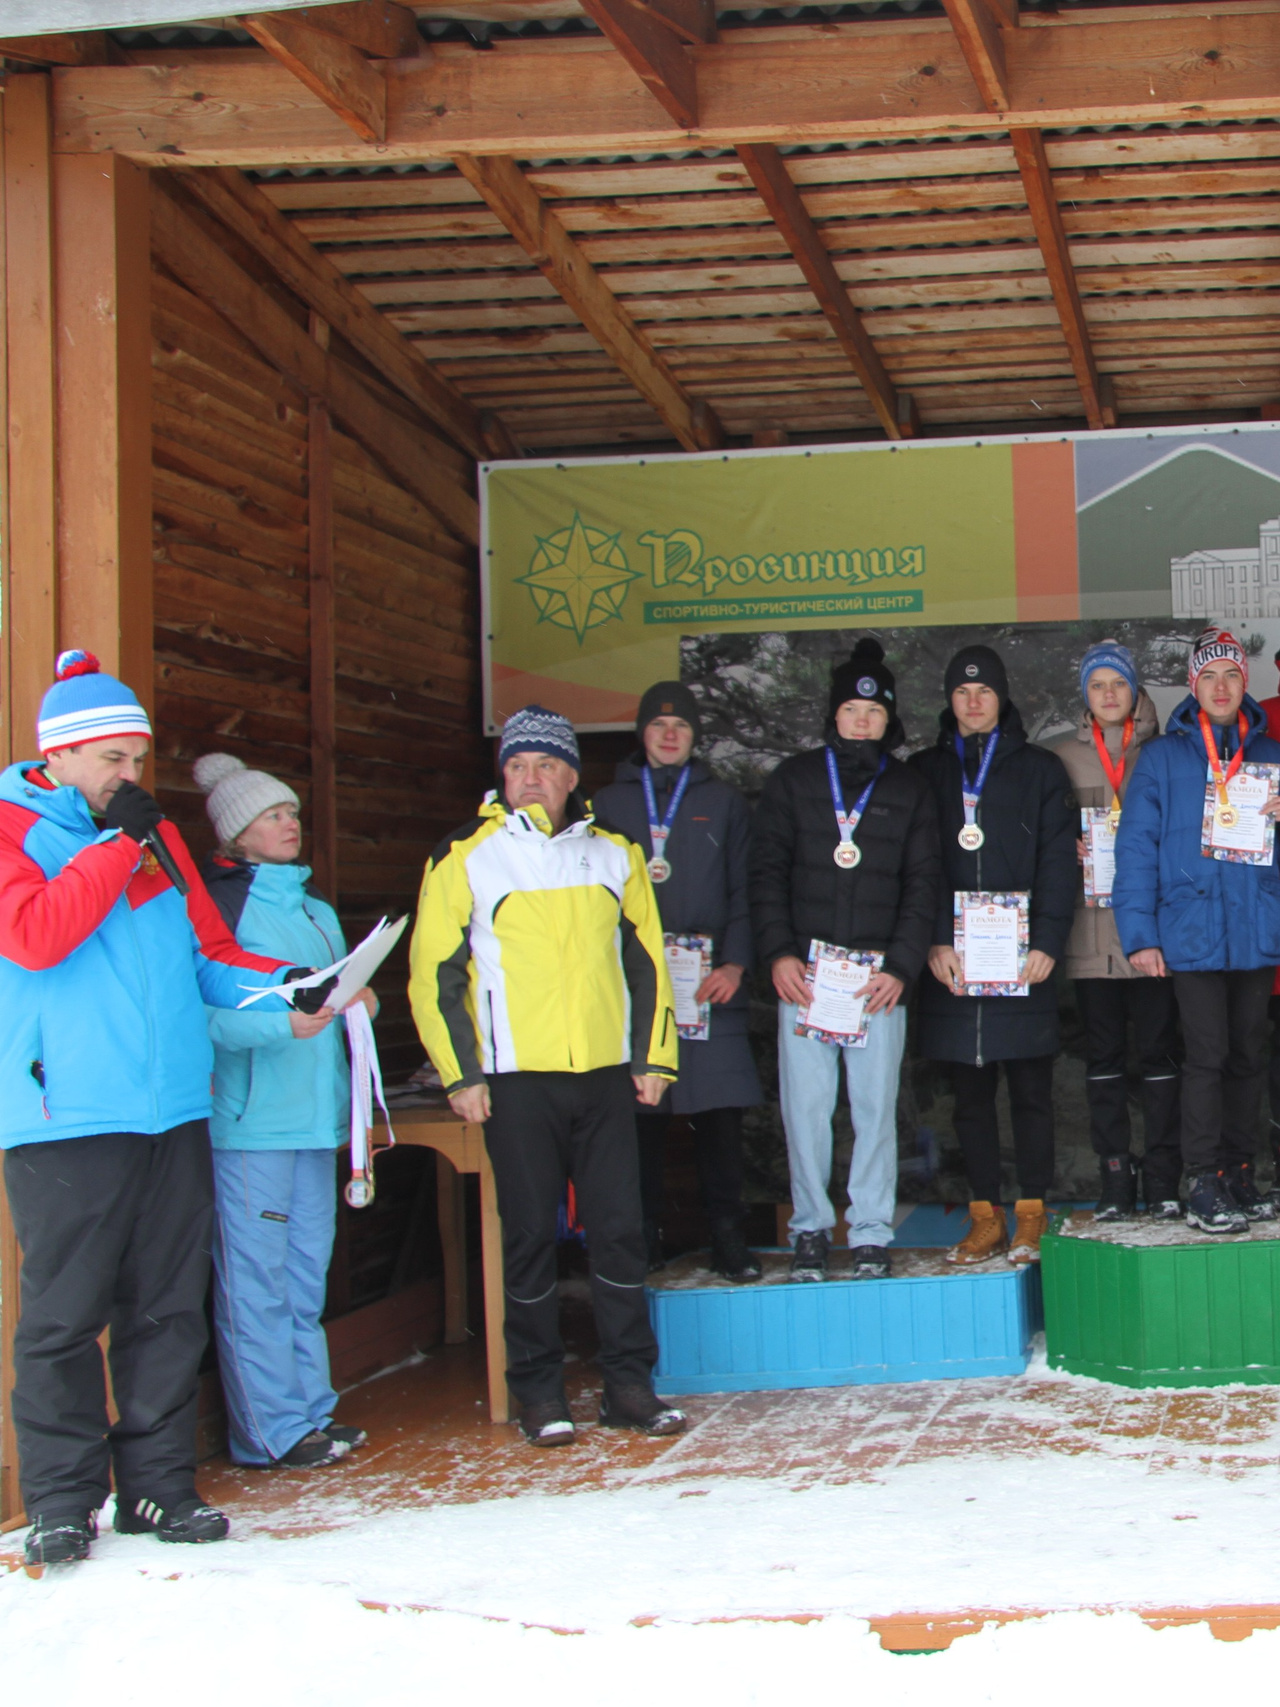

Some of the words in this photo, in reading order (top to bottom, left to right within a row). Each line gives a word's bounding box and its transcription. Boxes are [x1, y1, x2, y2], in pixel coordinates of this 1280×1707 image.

[637, 529, 925, 596] Провинция
[653, 596, 863, 619] СПОРТИВНО-ТУРИСТИЧЕСКИЙ
[867, 596, 914, 611] ЦЕНТР
[1193, 644, 1240, 672] EUROPE
[1227, 785, 1263, 794] РАМОТА
[971, 916, 1012, 924] ГРАМОТА
[822, 967, 864, 980] ГРАМОТА
